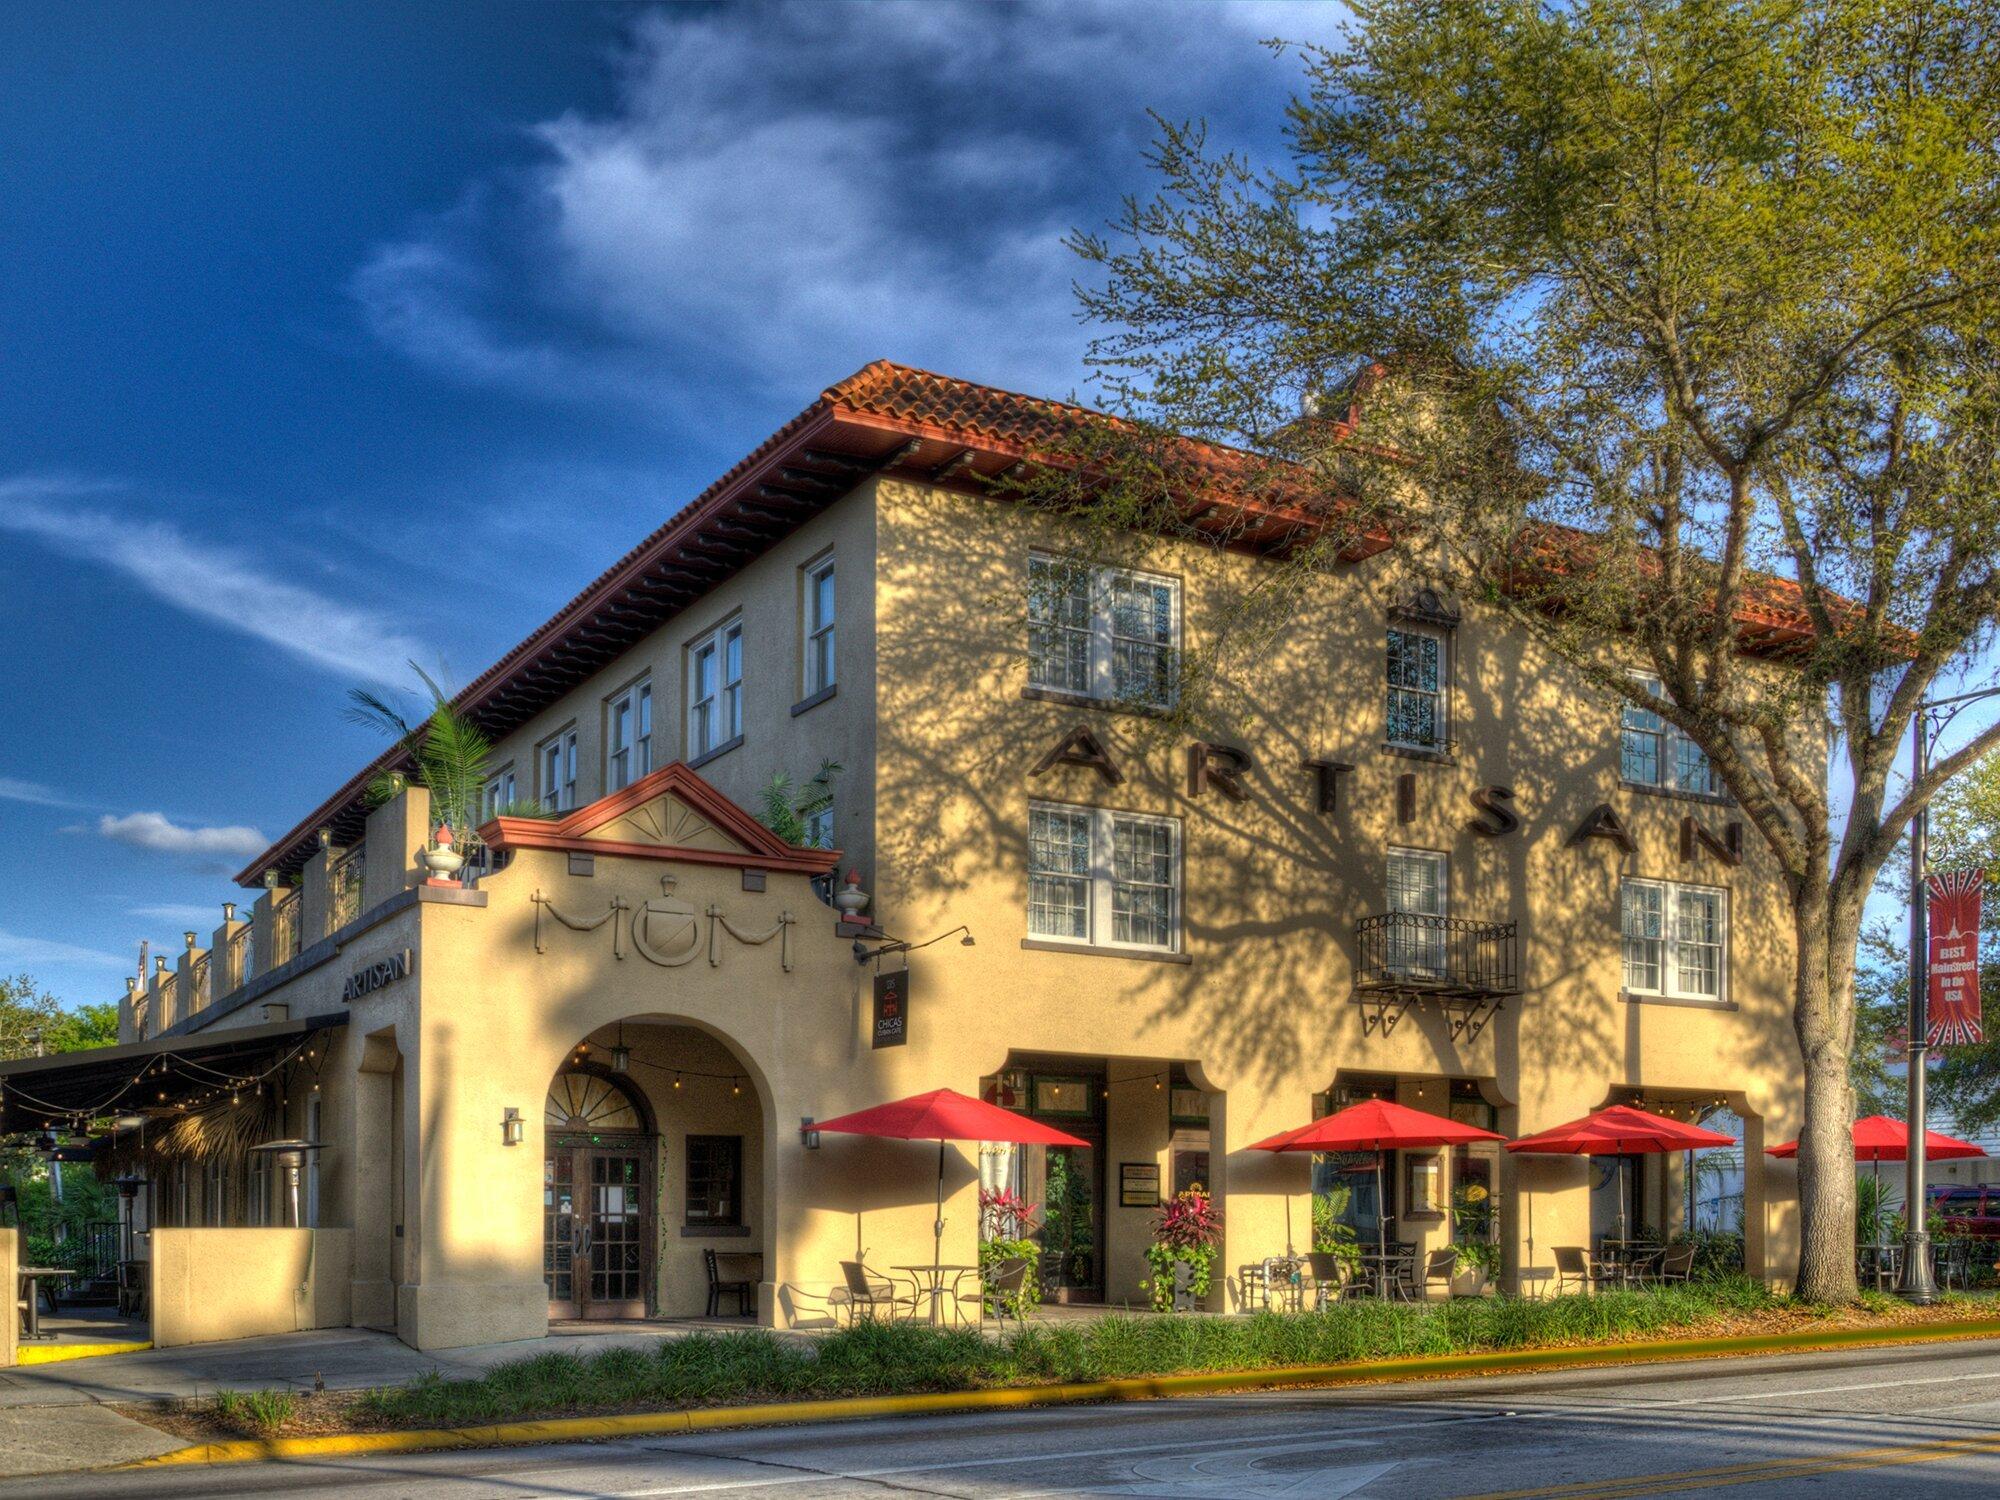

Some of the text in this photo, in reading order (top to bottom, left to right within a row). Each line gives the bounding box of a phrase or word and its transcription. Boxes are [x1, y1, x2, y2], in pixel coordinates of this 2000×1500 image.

[1027, 724, 1742, 867] ARTISAN
[1940, 946, 1966, 960] BEST
[342, 948, 412, 1003] ARTISAN
[1944, 990, 1963, 1002] USA
[877, 1016, 903, 1030] CHICAS
